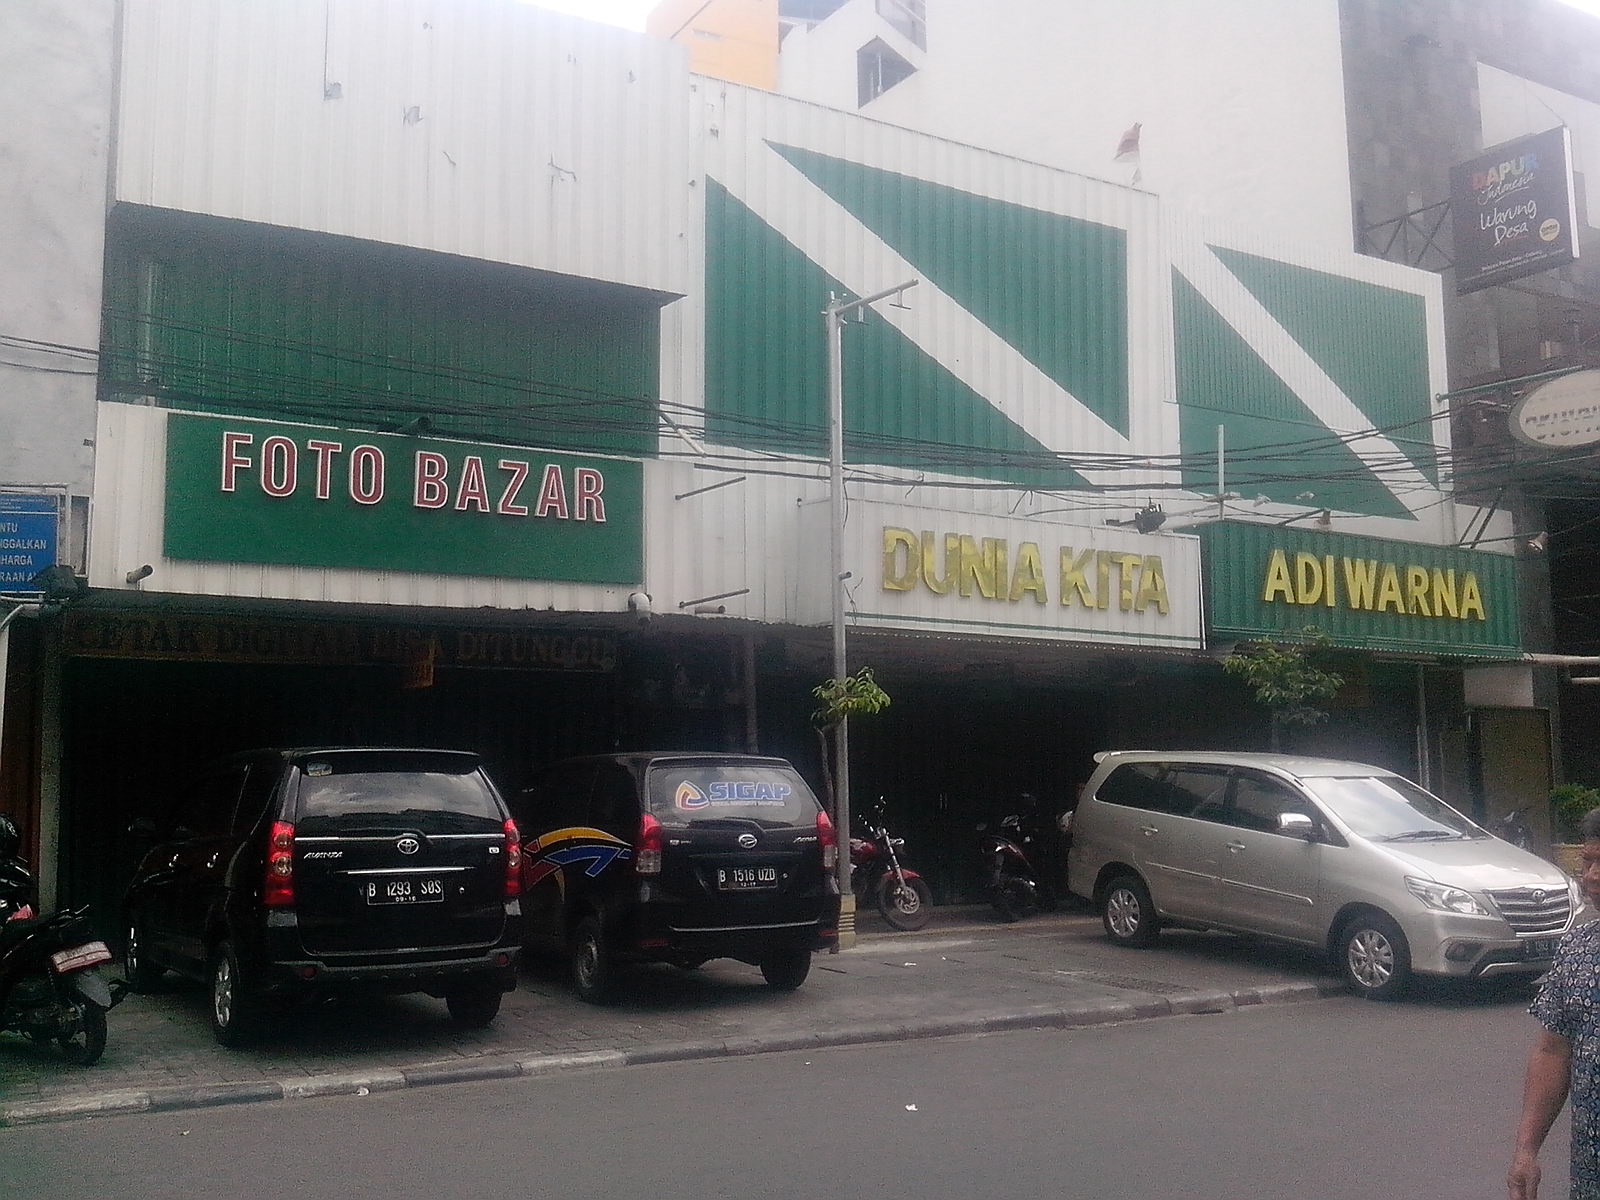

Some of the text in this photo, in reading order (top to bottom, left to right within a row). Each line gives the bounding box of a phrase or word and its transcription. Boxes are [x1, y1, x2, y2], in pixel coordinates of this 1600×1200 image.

[1480, 200, 1537, 230] Warung
[1494, 222, 1529, 246] Desa
[221, 431, 607, 522] FOTO BAZAR
[882, 525, 1170, 616] DUNIA KITA
[1264, 549, 1486, 620] ADI WARNA
[709, 781, 792, 801] SIGAP
[368, 882, 376, 897] B
[387, 881, 411, 896] 1293
[719, 868, 776, 883] B 1516 UZD
